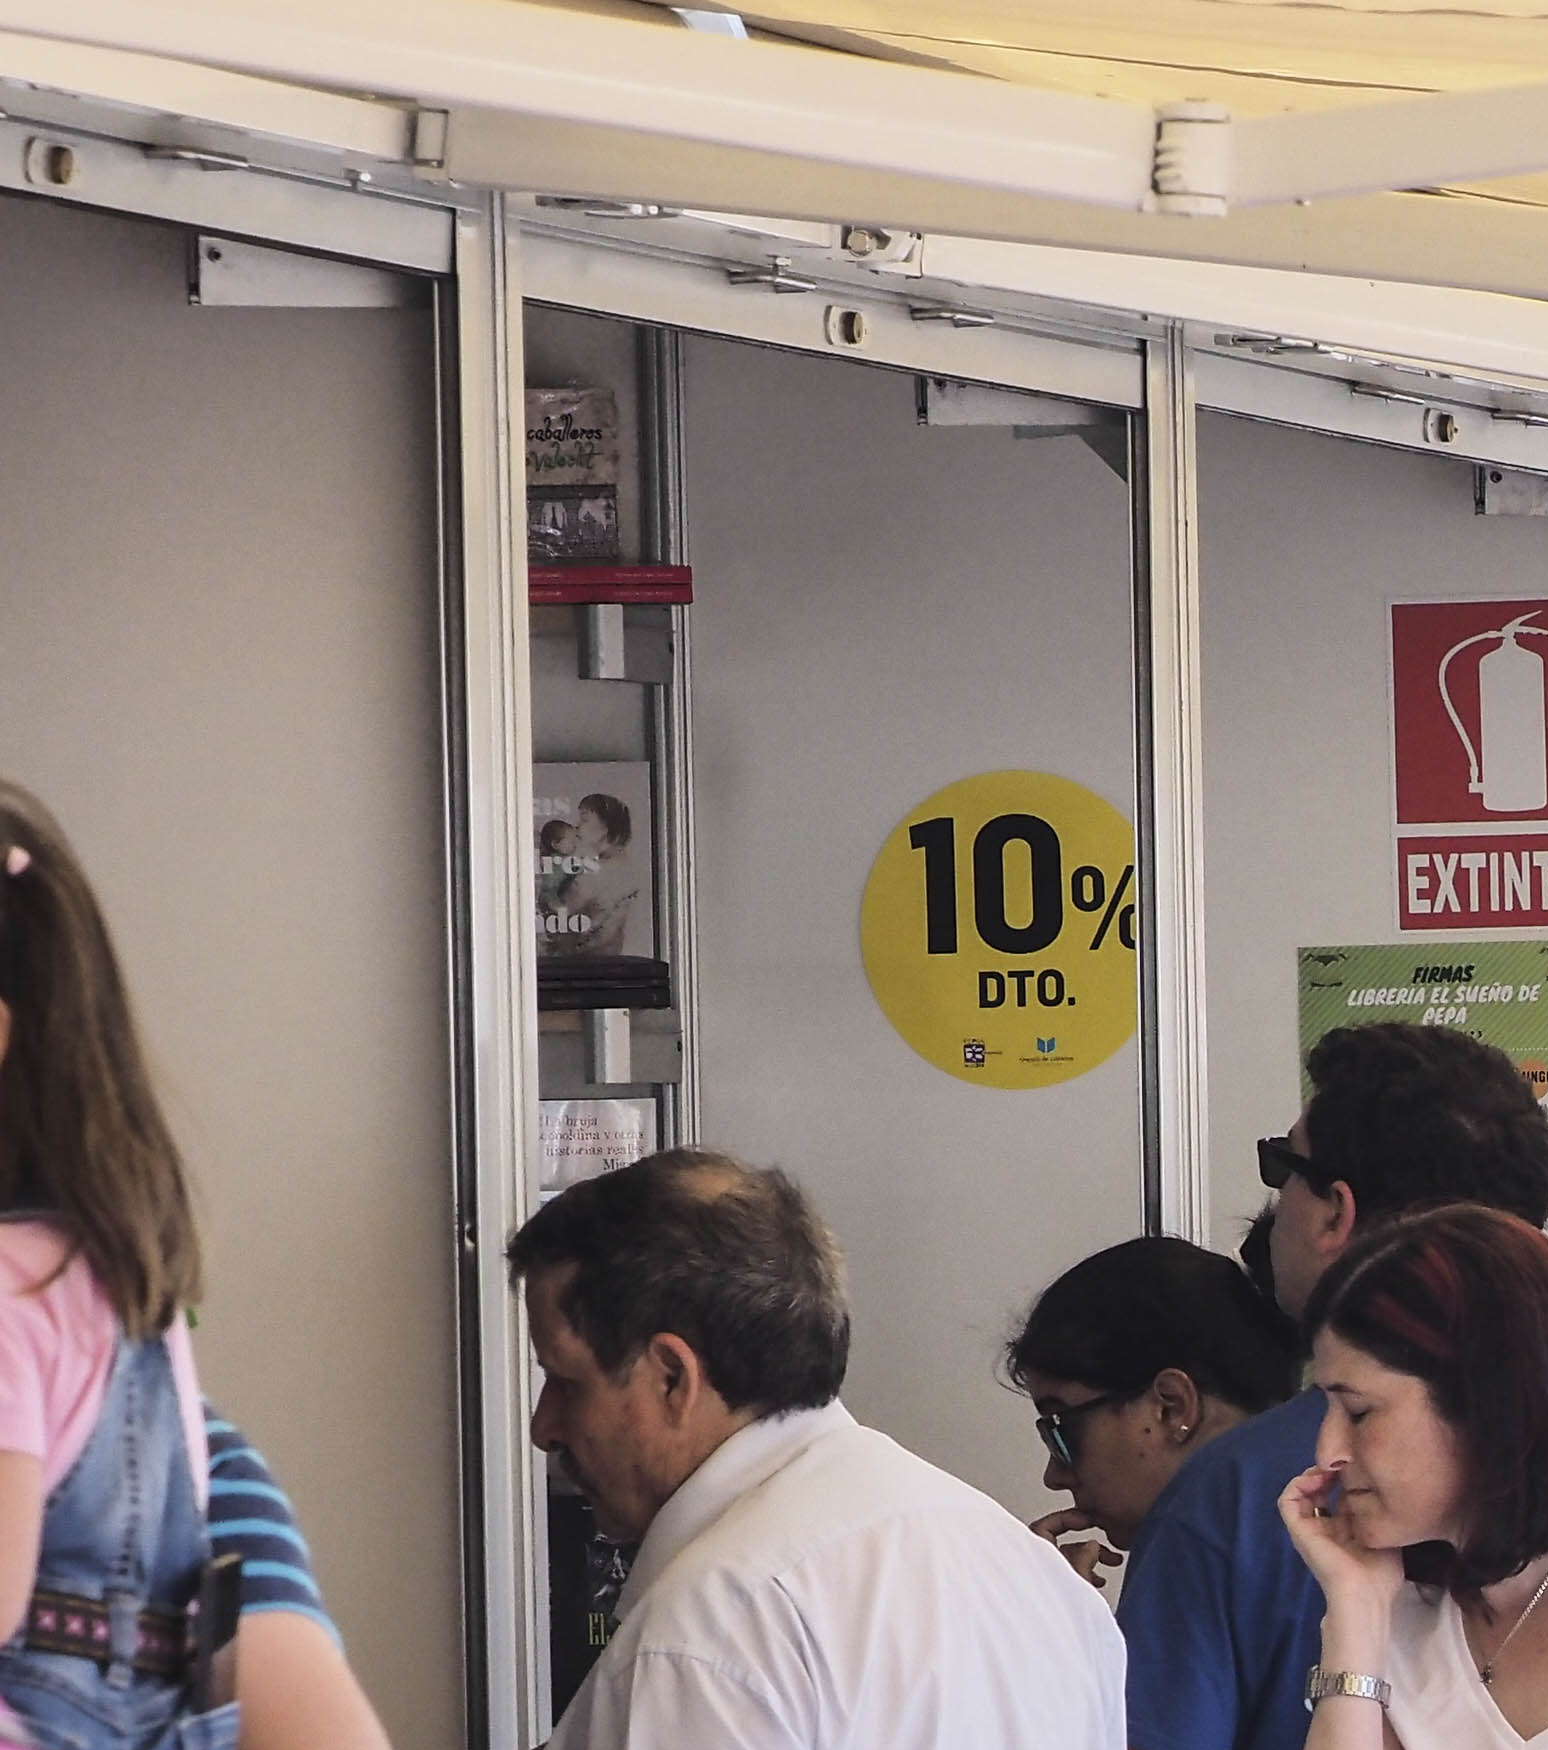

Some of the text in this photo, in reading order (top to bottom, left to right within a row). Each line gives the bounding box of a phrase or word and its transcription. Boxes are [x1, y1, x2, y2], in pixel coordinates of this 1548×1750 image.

[527, 414, 602, 441] caballeros
[909, 813, 1136, 954] 10%
[1412, 964, 1475, 985] FIRMAS
[978, 968, 1076, 1009] DTO.
[1347, 982, 1543, 1008] LIBRERIA EL SUEÑO DE
[1422, 1006, 1468, 1026] PEPA
